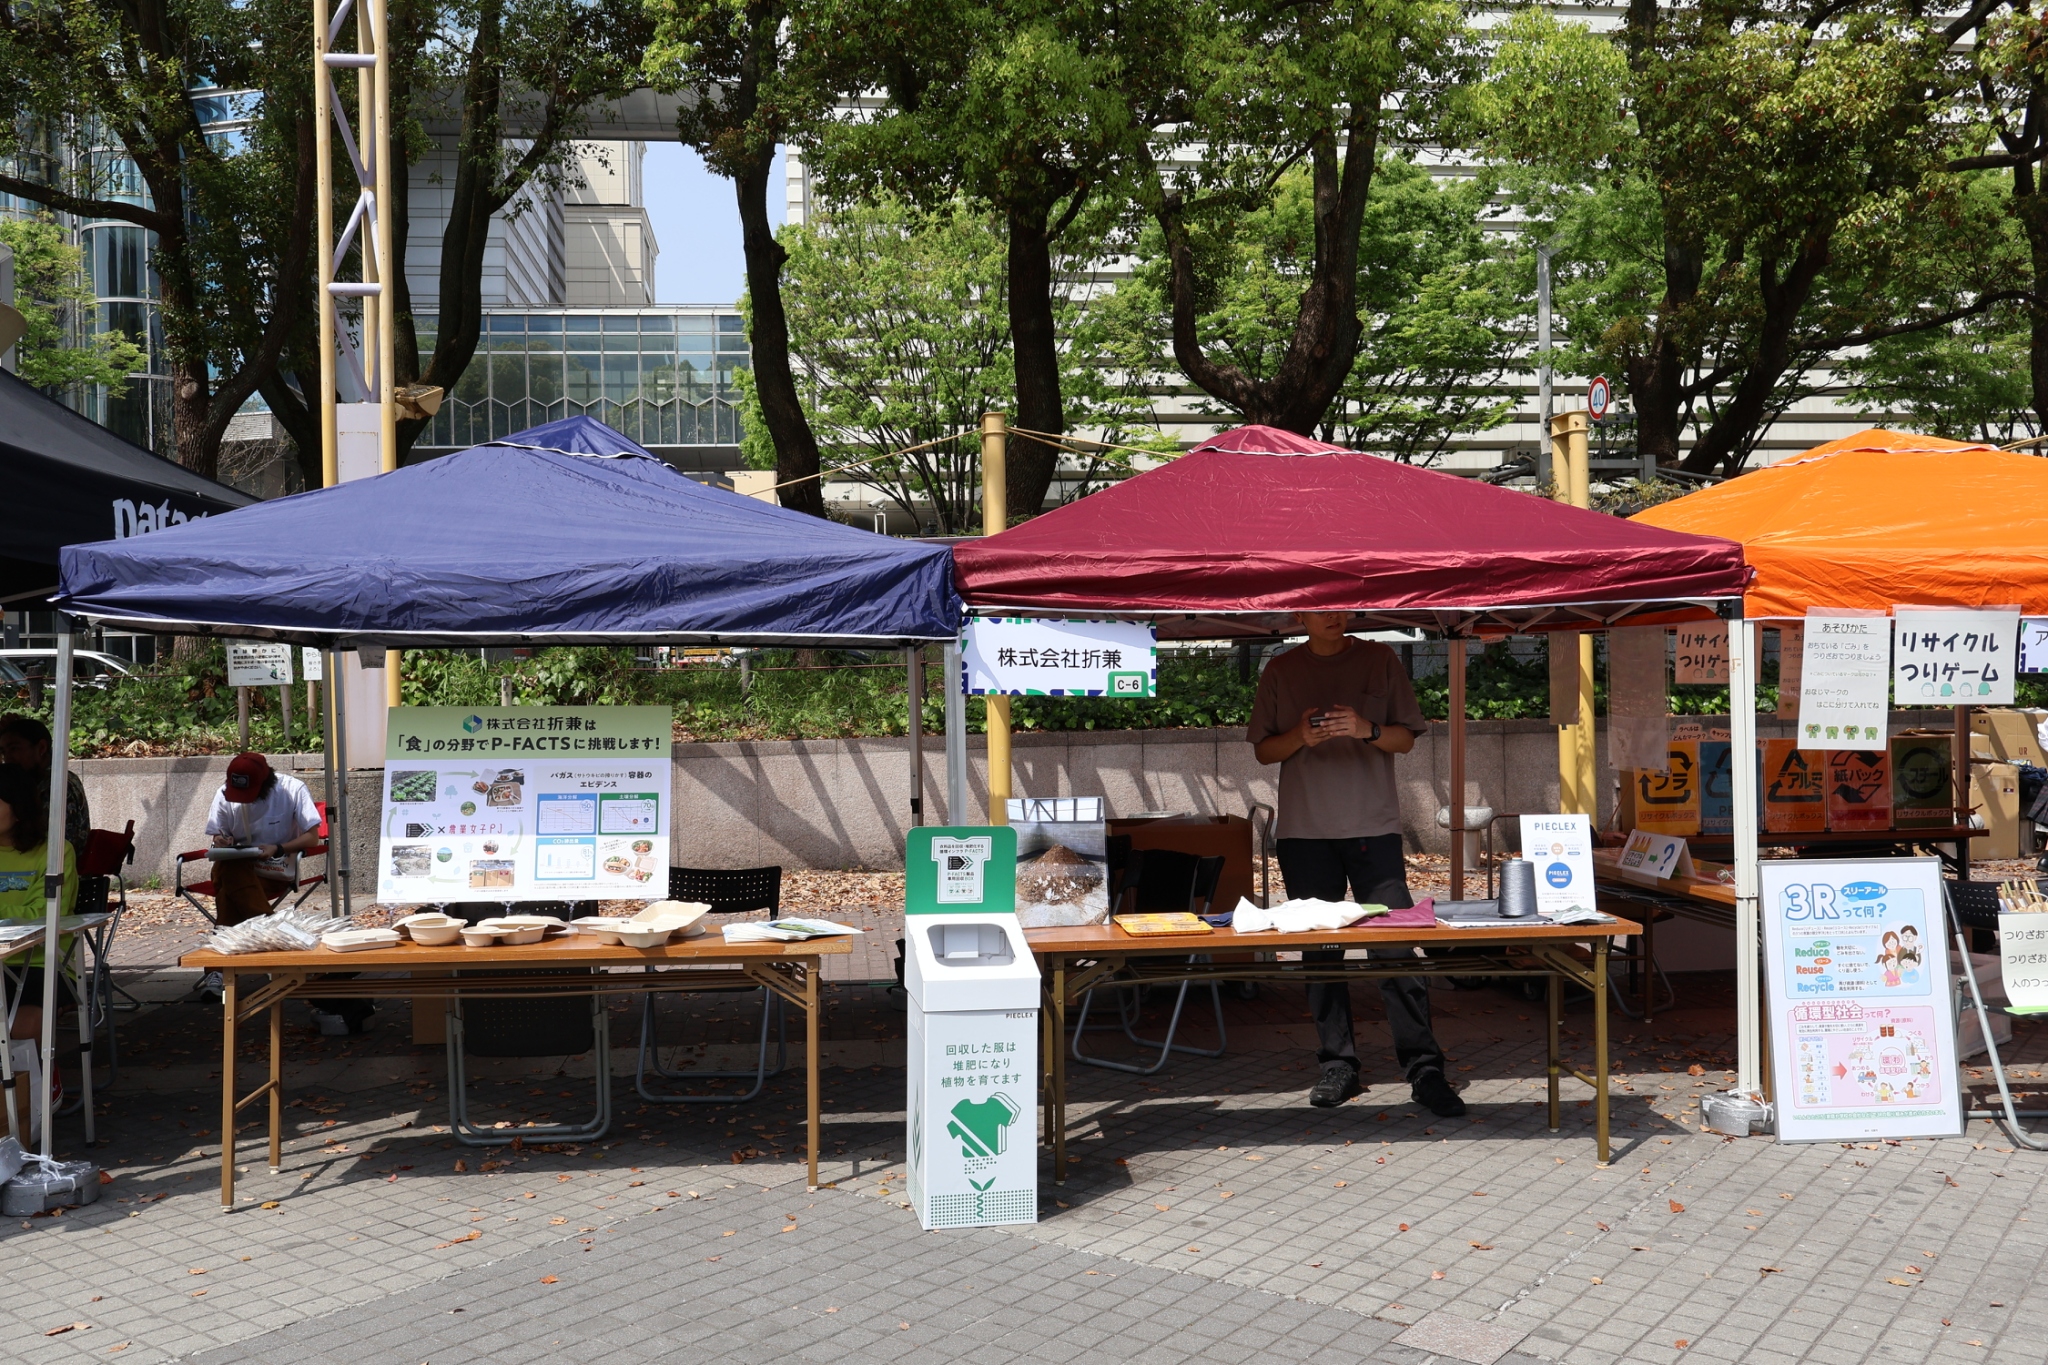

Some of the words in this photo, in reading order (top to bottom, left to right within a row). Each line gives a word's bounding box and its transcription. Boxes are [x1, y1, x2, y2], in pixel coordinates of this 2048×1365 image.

[1593, 388, 1604, 408] 40
[1822, 623, 1868, 634] あそびかた
[1900, 631, 2000, 653] リサイクル
[997, 647, 1122, 670] 株式会社折兼
[1813, 652, 1882, 660] つりざおでつりましょう
[1900, 662, 2000, 683] つりゲーム
[1117, 679, 1139, 691] C-6
[486, 716, 597, 732] 株式会社折兼は
[398, 734, 660, 752] 「食」の分野でP-FACTSに挑戦します!
[2019, 747, 2028, 756] UR
[1654, 768, 1688, 791] プラ
[1788, 772, 1823, 790] アルミ
[1834, 768, 1884, 782] 紙パック
[1910, 768, 1948, 784] スチール
[1534, 822, 1577, 830] PIECLEX
[1843, 886, 1886, 894] スリーアール
[1784, 884, 1840, 921] 3R
[1843, 903, 1887, 918] って何？
[2004, 930, 2048, 940] つりざお
[1795, 948, 1830, 957] Reduce
[1796, 966, 1824, 974] Reuse
[1797, 983, 1834, 994] Recycle
[1794, 1004, 1863, 1021] 循環型社会
[1864, 1009, 1891, 1018] って何？
[946, 1042, 1016, 1056] 回収した服は
[953, 1058, 1011, 1071] 堆肥になり
[940, 1072, 1022, 1088] 植物を育てます
